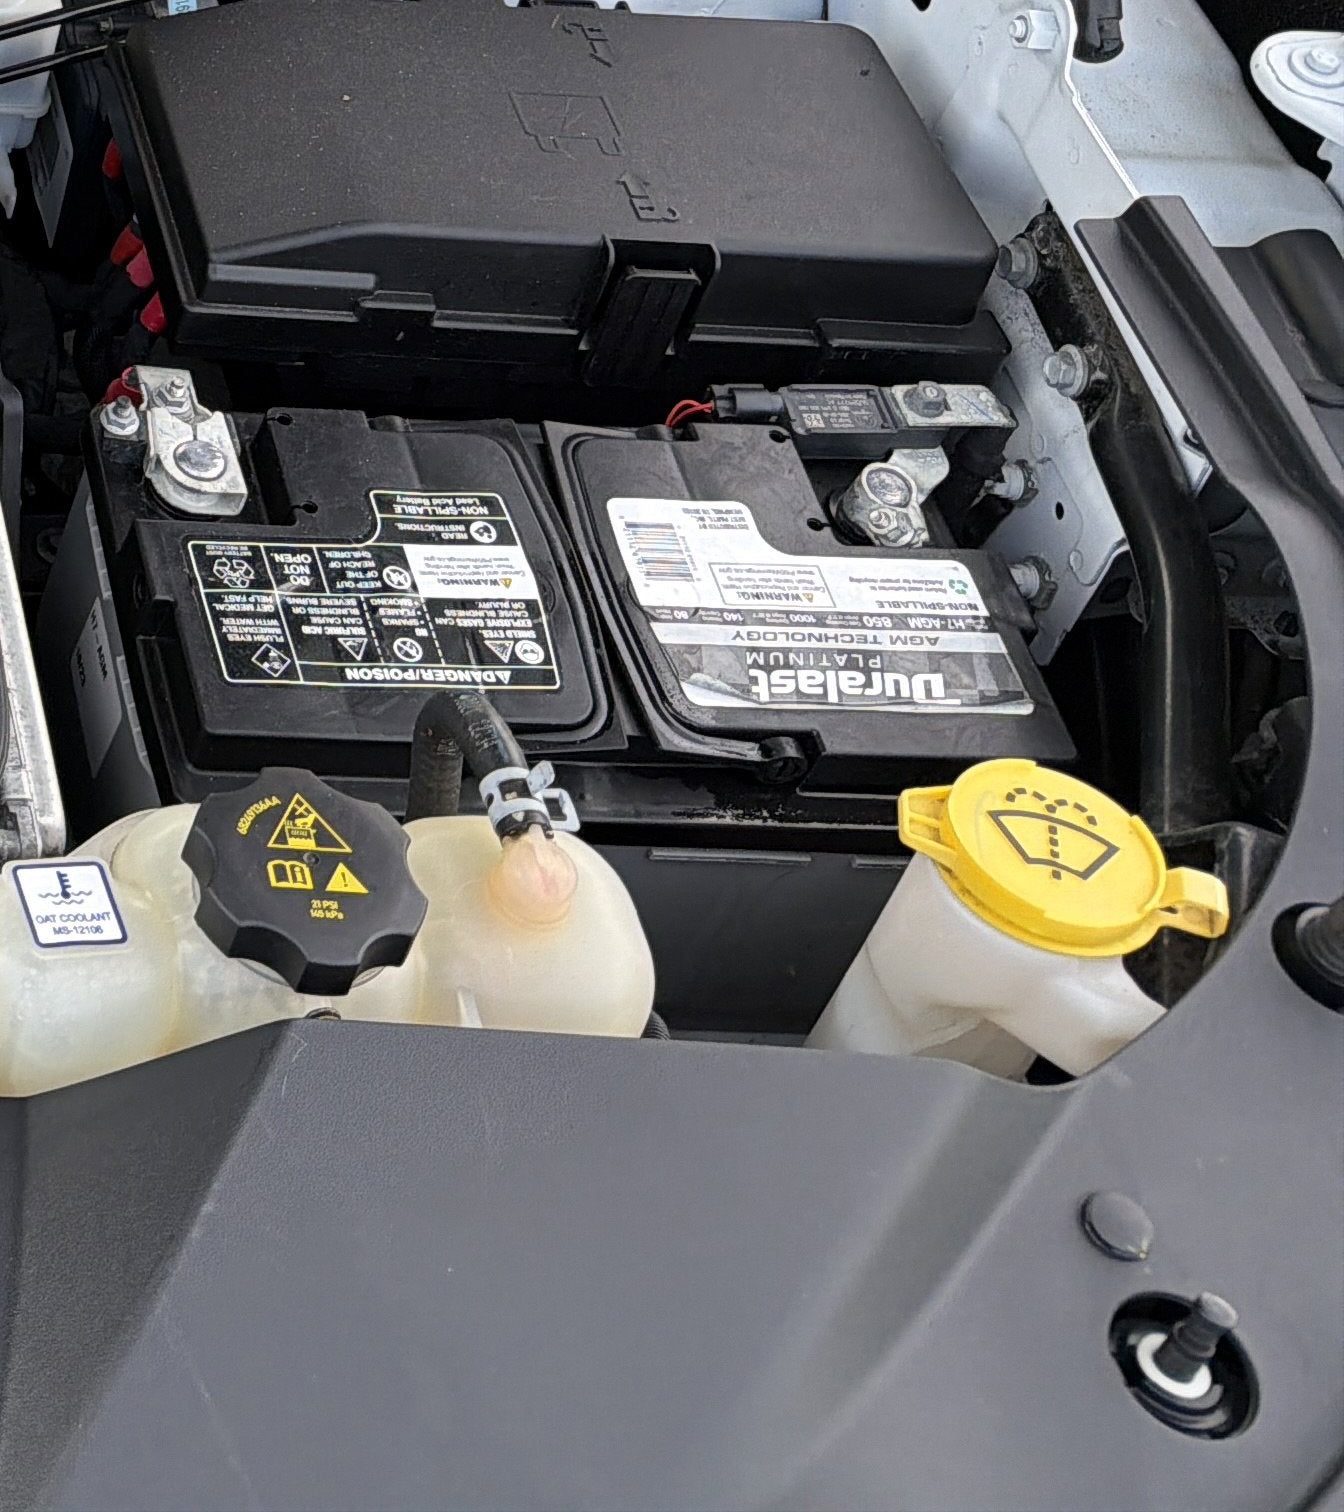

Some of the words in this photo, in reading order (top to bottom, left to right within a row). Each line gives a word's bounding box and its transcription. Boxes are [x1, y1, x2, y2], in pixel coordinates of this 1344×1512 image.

[395, 495, 430, 504] Battery
[393, 504, 489, 515] NON-SPILLABLE
[270, 553, 312, 563] OPEN.
[283, 565, 310, 575] NOT
[290, 575, 310, 586] DO
[736, 591, 803, 602] WARNING:
[875, 600, 979, 611] NON-SPILLABLE
[723, 611, 743, 621] 140
[862, 615, 892, 627] 850
[731, 630, 882, 645] TECHNOLOGY
[888, 634, 940, 646] AGM
[746, 651, 881, 668] PLATINUM
[345, 668, 496, 682] DANGER/POISON
[749, 669, 961, 705] Duralast
[36, 914, 56, 924] OAT
[59, 912, 110, 922] COOLANT
